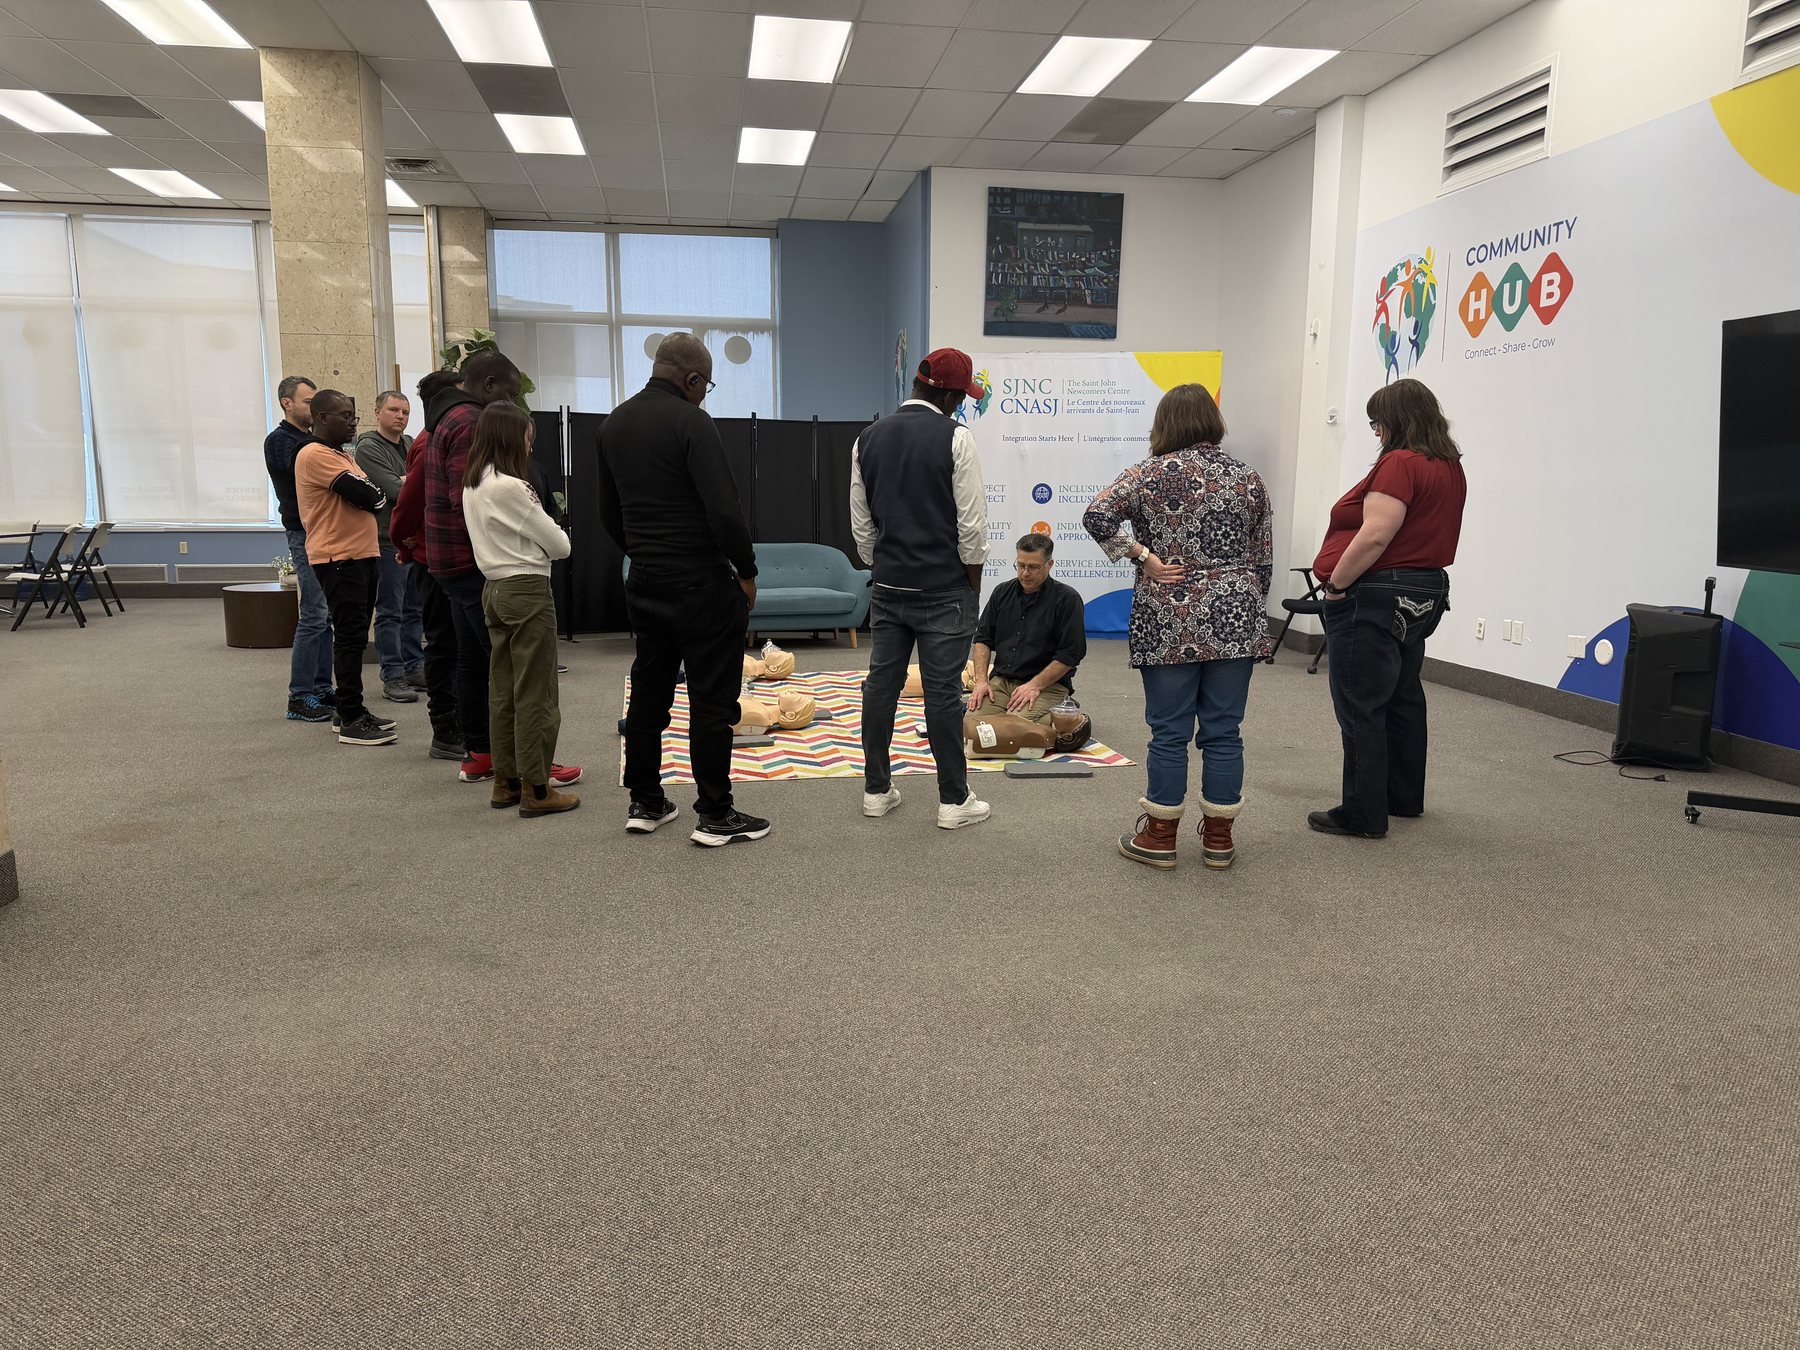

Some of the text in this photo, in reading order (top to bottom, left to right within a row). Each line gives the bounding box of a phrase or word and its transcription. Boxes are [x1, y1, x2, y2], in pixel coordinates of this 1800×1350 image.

[1466, 216, 1578, 266] COMMUNITY
[1468, 271, 1561, 322] HUB
[1464, 346, 1496, 360] Connect
[1502, 343, 1526, 354] Share
[1532, 337, 1556, 349] Grow
[1003, 378, 1052, 397] SJNC
[1082, 379, 1100, 387] Saint
[1100, 379, 1117, 388] John
[1107, 387, 1130, 395] Centre
[1000, 398, 1059, 417] CNASJ
[1105, 407, 1140, 415] Saint-Jean
[1002, 435, 1038, 443] Integration
[1056, 533, 1093, 541] APPROC
[985, 559, 1007, 567] NESS
[1055, 559, 1093, 567] SERVICE
[984, 568, 999, 576] ITÉ
[1055, 570, 1113, 578] EXCELLENCE
[1116, 570, 1130, 578] DU
